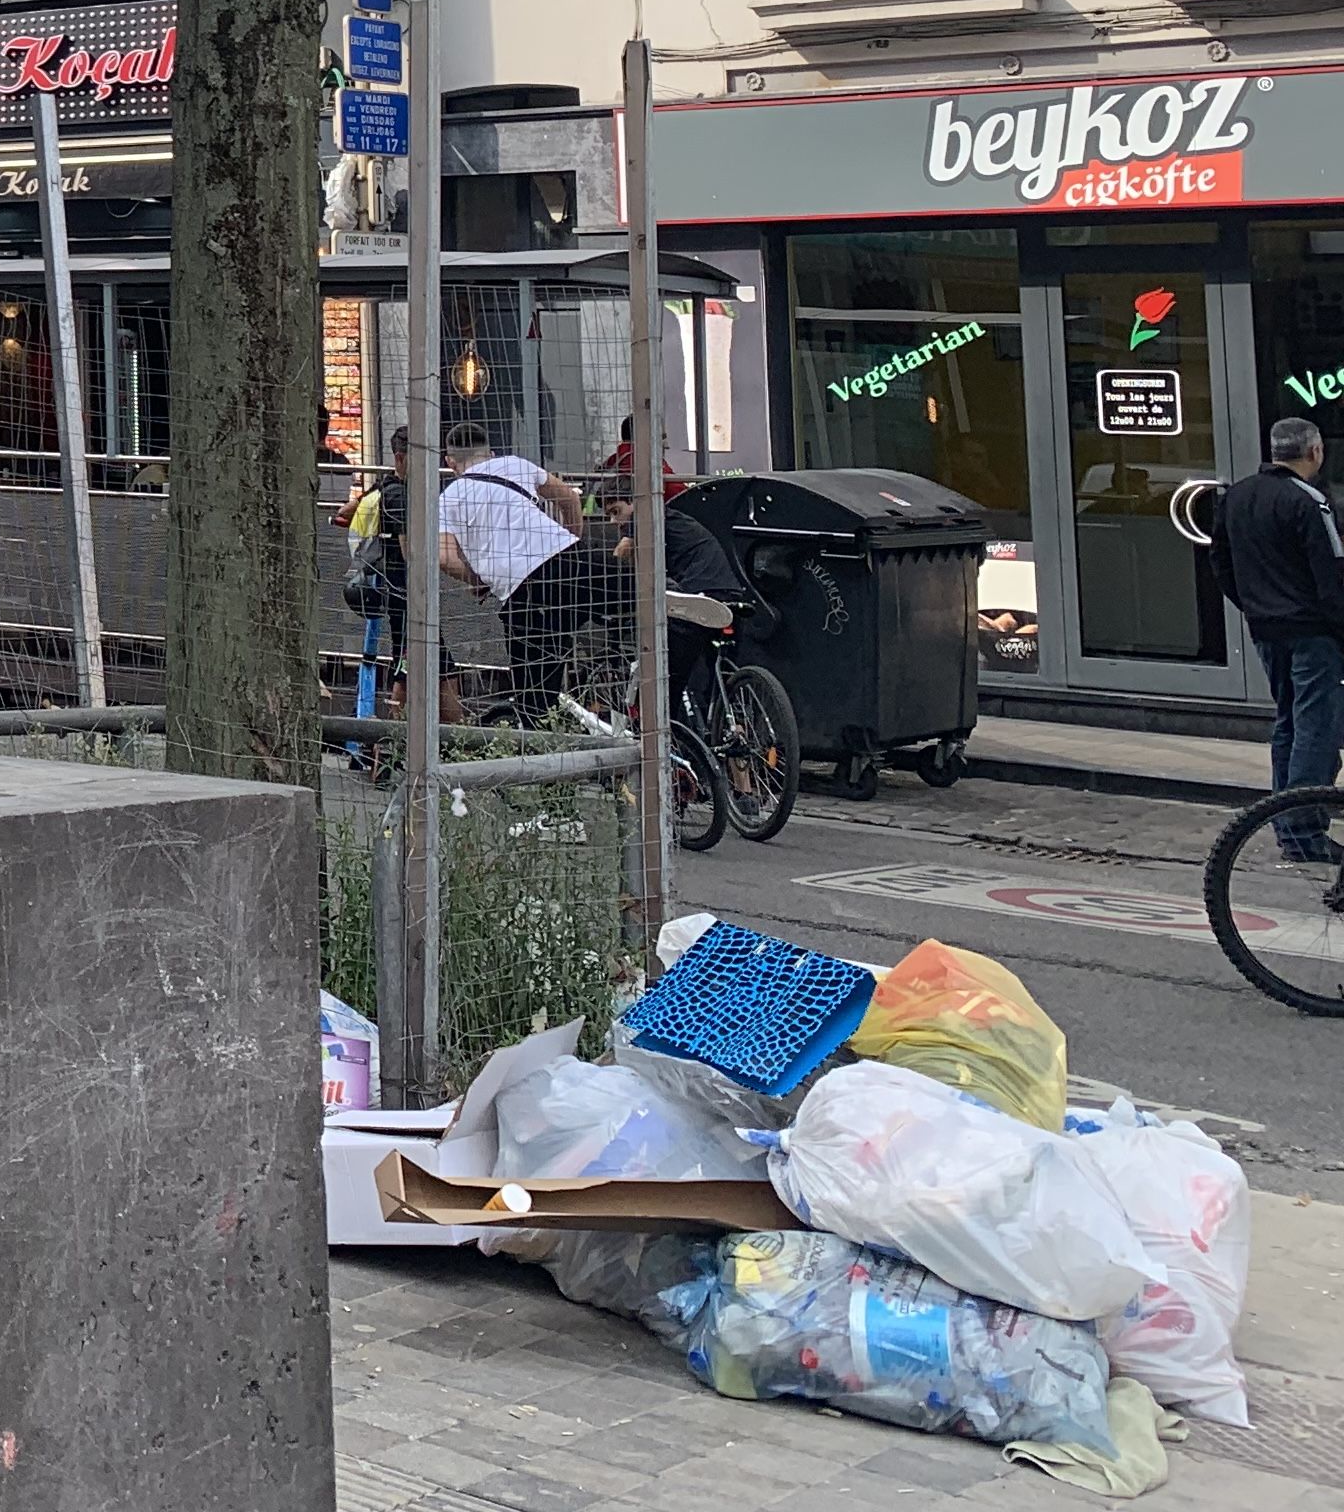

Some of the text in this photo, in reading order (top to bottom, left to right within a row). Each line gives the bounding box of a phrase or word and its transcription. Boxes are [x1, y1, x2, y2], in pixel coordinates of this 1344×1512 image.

[365, 94, 391, 104] MARDI
[360, 136, 370, 150] 11
[386, 138, 399, 152] 17
[928, 77, 1248, 200] beykoz
[345, 235, 370, 246] FORFAIT
[374, 237, 386, 247] 100
[828, 321, 987, 402] Vegetarian
[1284, 367, 1344, 408] Ve
[1104, 392, 1174, 404] Tous les jours
[1117, 404, 1163, 414] ouvert de
